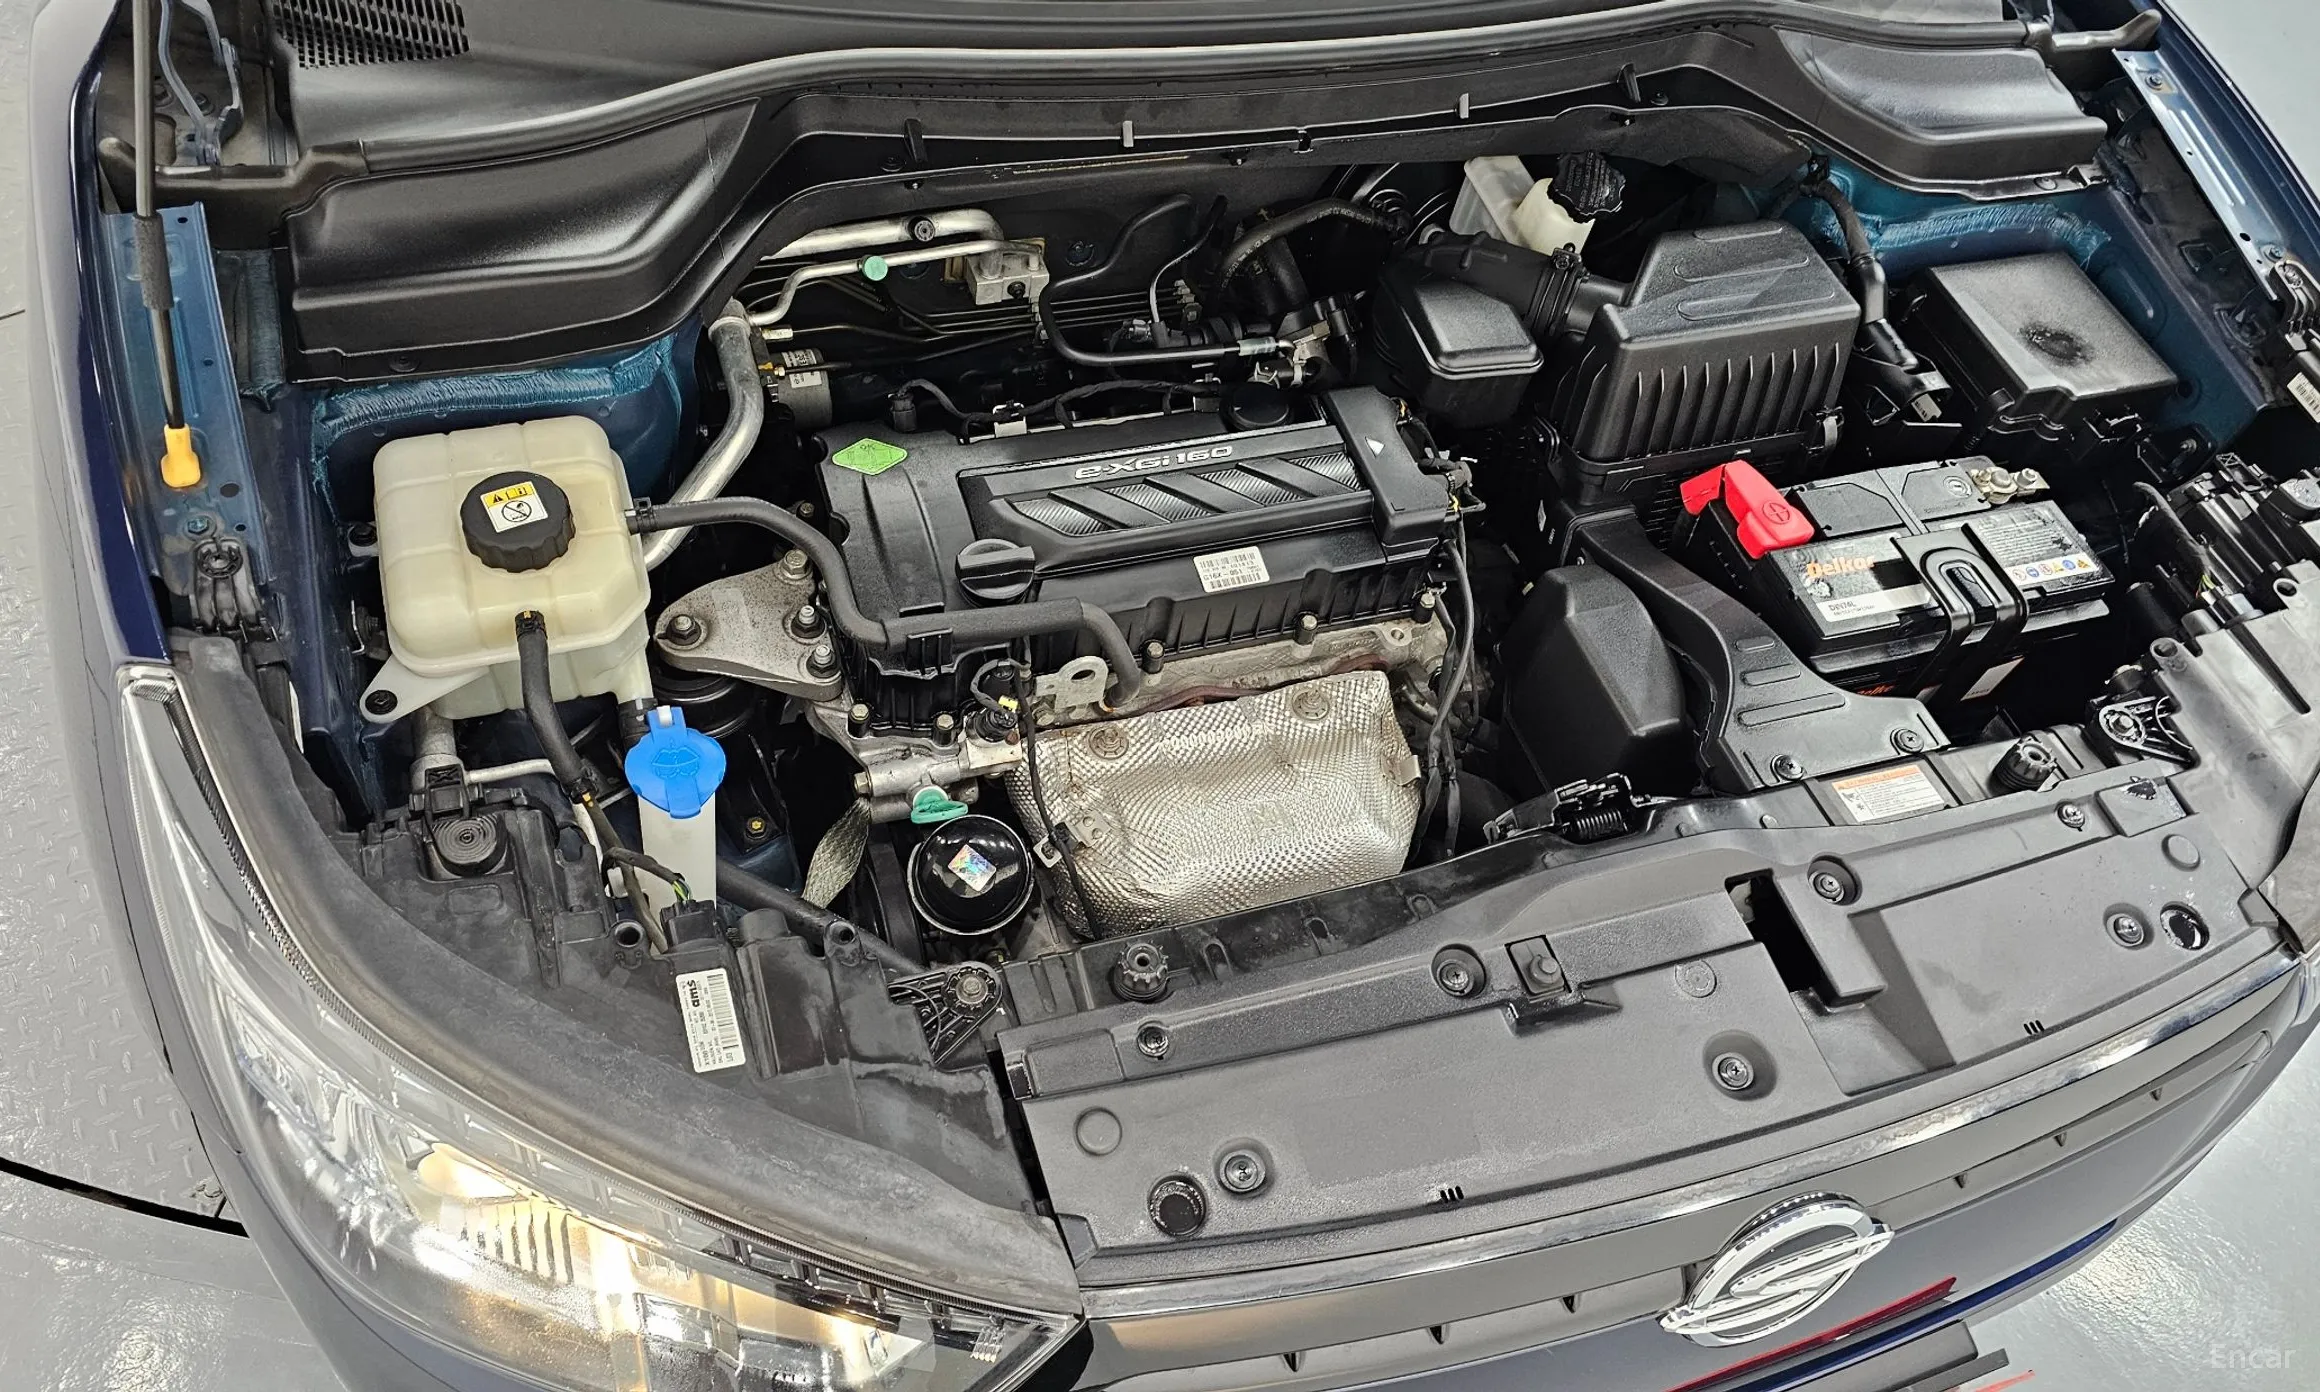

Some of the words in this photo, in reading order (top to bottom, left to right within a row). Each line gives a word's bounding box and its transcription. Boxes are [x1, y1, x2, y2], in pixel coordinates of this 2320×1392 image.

[1176, 445, 1233, 465] 160
[1806, 555, 1876, 579] Delkor
[687, 980, 701, 1008] ams
